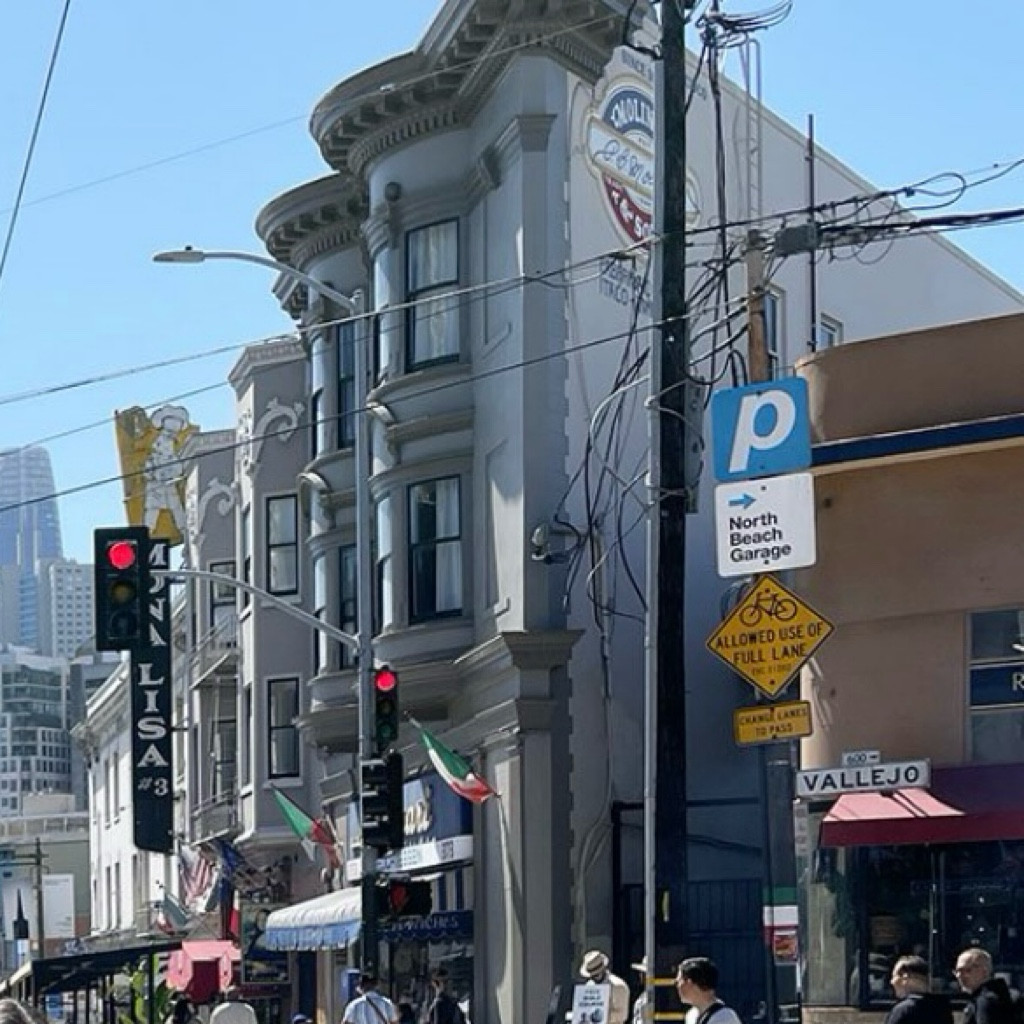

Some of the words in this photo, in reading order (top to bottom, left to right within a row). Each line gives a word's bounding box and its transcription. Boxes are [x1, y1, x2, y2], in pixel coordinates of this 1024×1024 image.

[729, 511, 778, 530] North
[729, 527, 783, 547] Beach
[730, 543, 792, 563] Garage
[716, 629, 775, 649] ALLOWED
[779, 624, 804, 640] USE
[807, 621, 824, 638] OF
[733, 649, 765, 665] FULL
[771, 643, 808, 661] LANE
[137, 663, 168, 768] LISA
[739, 712, 775, 726] CHANGE
[777, 708, 807, 720] LANES
[755, 725, 766, 735] TO
[769, 722, 794, 733] PASS
[846, 753, 867, 764] 600
[138, 777, 168, 796] #3
[803, 766, 920, 791] VALLEJO
